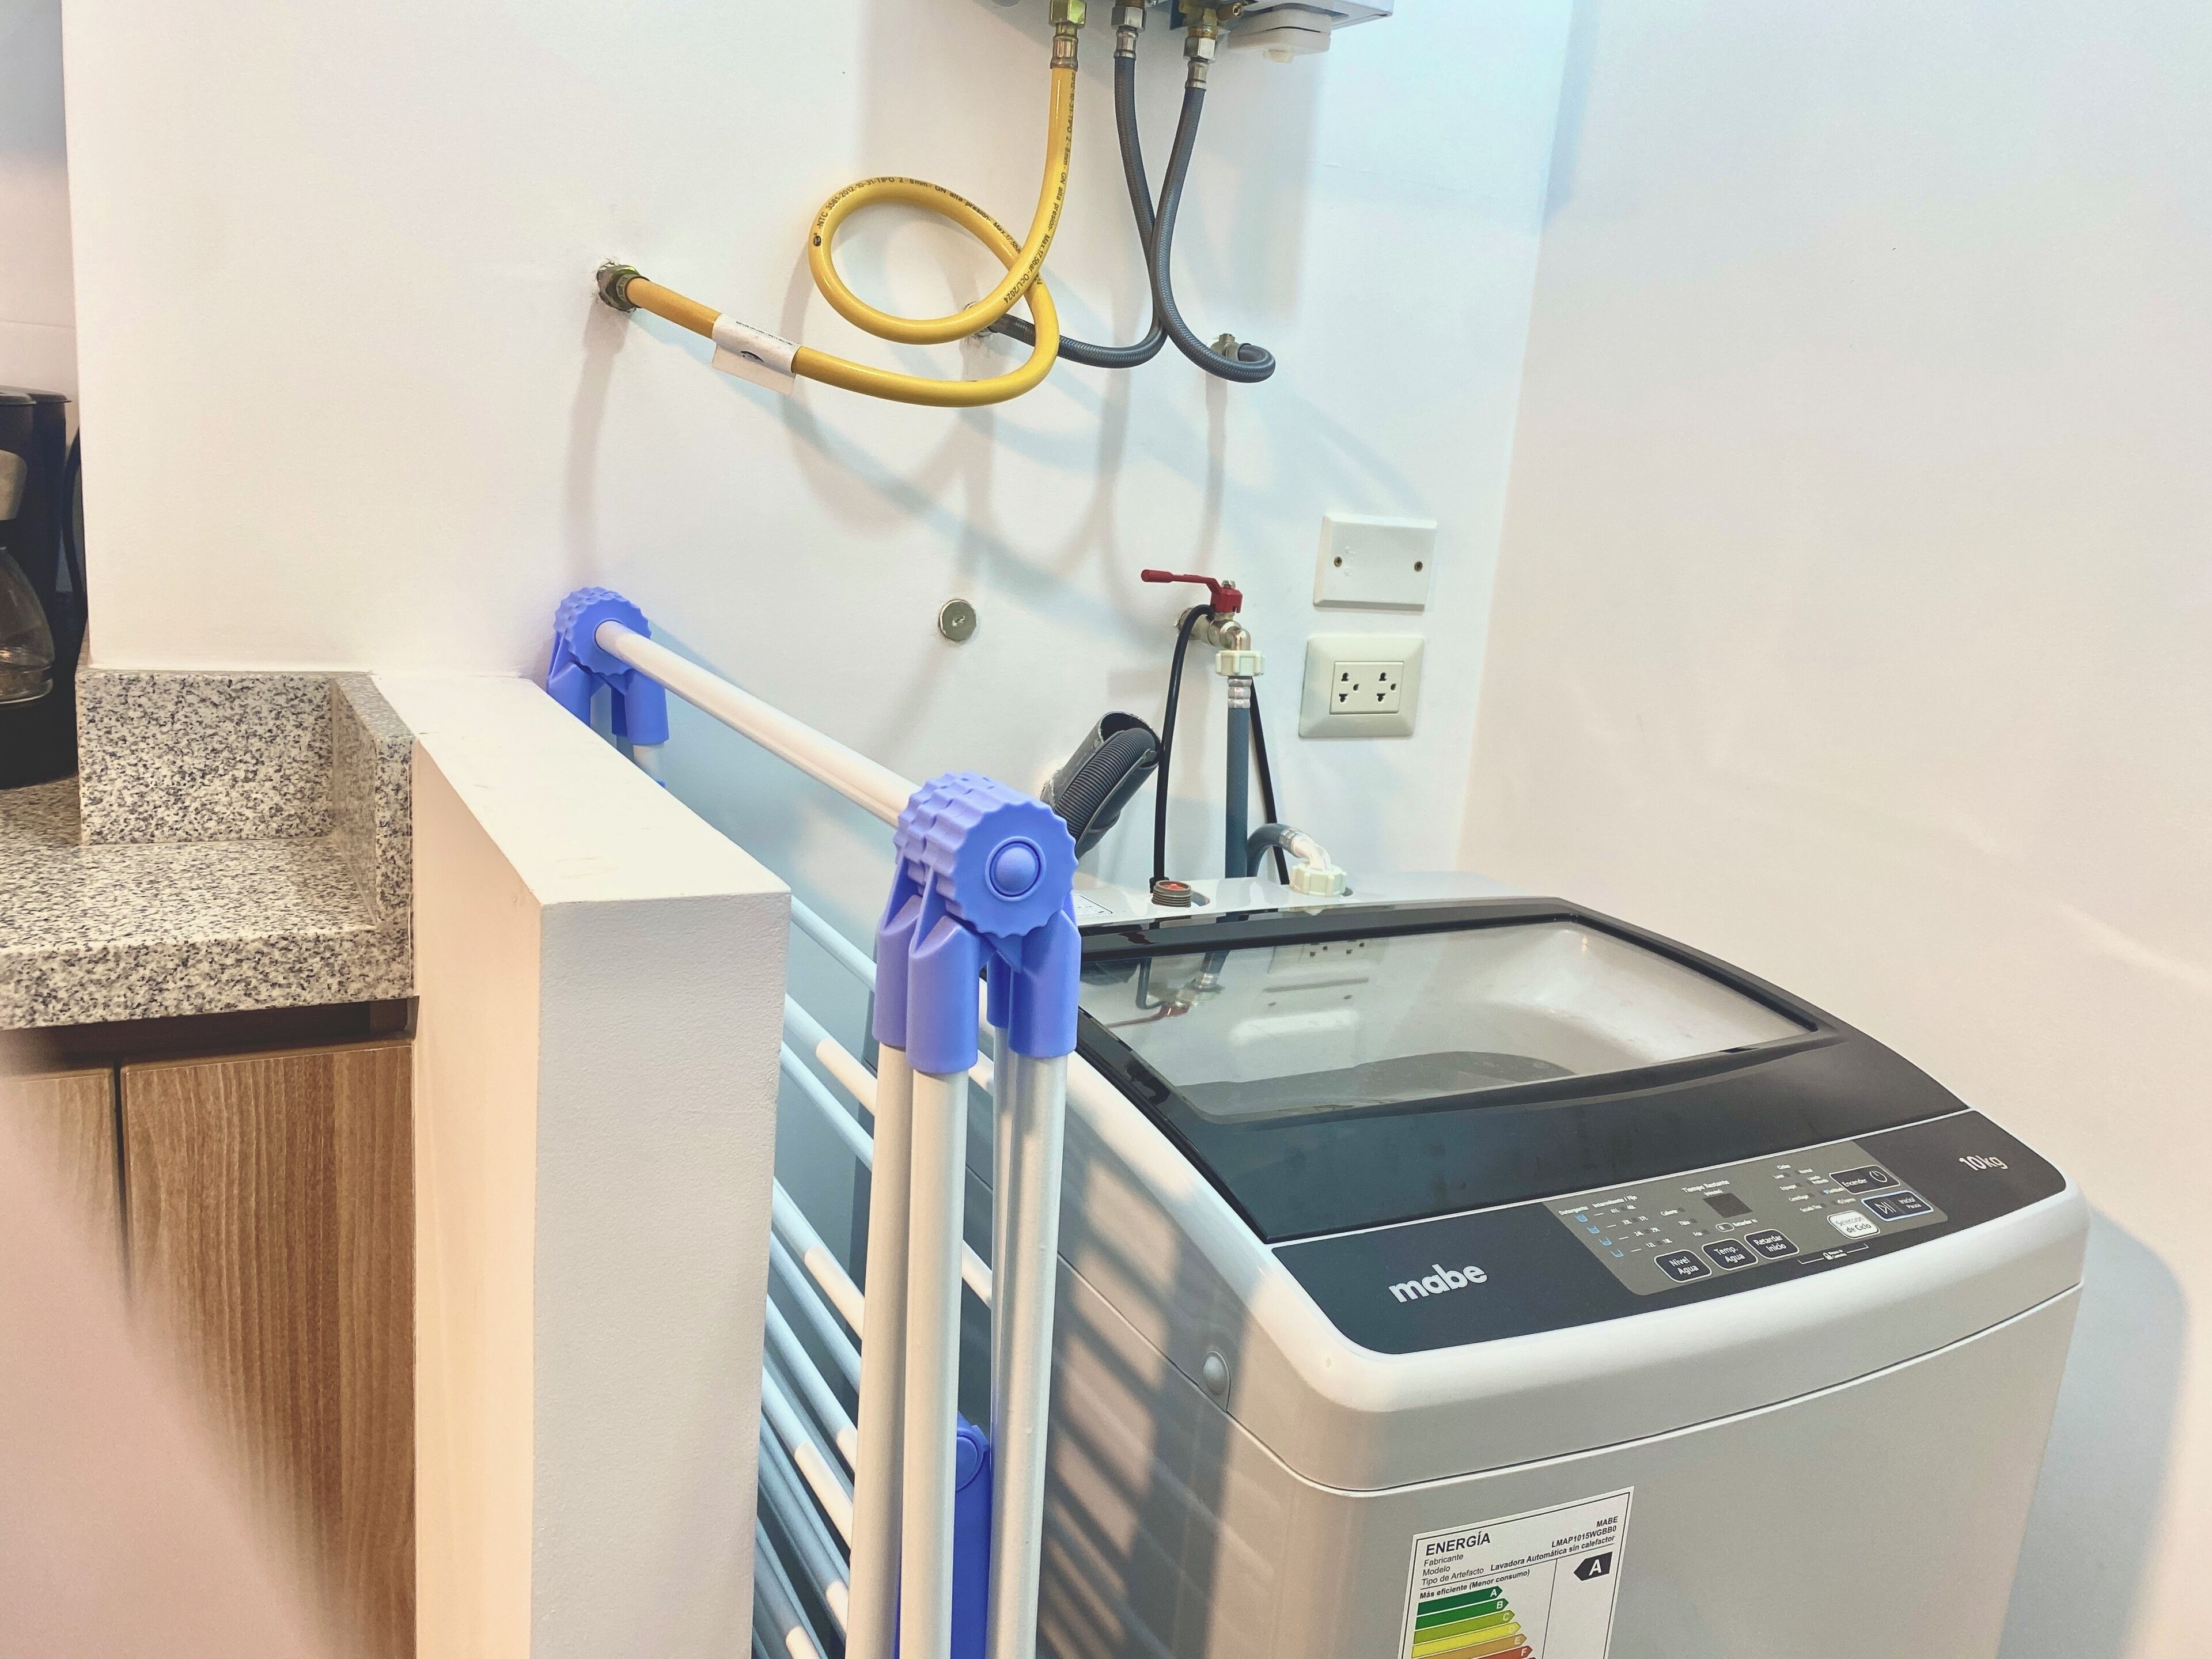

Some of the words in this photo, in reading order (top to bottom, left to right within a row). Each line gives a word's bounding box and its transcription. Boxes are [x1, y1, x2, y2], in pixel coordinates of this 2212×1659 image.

[1060, 172, 1066, 184] GN
[935, 185, 946, 194] GN
[950, 192, 963, 202] alta
[1959, 1155, 2008, 1171] 10kg
[1682, 1184, 1705, 1194] Tiempo
[1704, 1180, 1730, 1189] Restante
[1753, 1234, 1783, 1247] Retardar
[1714, 1245, 1739, 1256] Temp.
[1766, 1243, 1787, 1252] Inicio
[1668, 1256, 1691, 1267] Nivel
[1724, 1253, 1746, 1264] Agua
[1677, 1265, 1699, 1275] Agua
[1388, 1264, 1487, 1303] mabe
[1596, 1516, 1619, 1528] MABE
[1426, 1531, 1491, 1556] ENERGÍA
[1421, 1578, 1438, 1586] Tipo
[1440, 1574, 1449, 1582] de
[1450, 1567, 1484, 1580] Artefacto
[1490, 1558, 1525, 1571] Lavadora
[1527, 1548, 1567, 1563] Automática
[1569, 1544, 1580, 1552] sin
[1581, 1535, 1615, 1549] calefactor
[1424, 1554, 1464, 1567] Fabricante
[1422, 1565, 1450, 1577] Modelo
[1588, 1559, 1602, 1577] A
[1419, 1591, 1434, 1599] Más
[1437, 1585, 1467, 1596] eficiente
[1469, 1578, 1494, 1590] (Menor
[1495, 1569, 1530, 1583] consumo)
[1490, 1589, 1497, 1597] A
[1497, 1601, 1503, 1609] B
[1503, 1613, 1509, 1621] C
[1521, 1648, 1527, 1657] F
